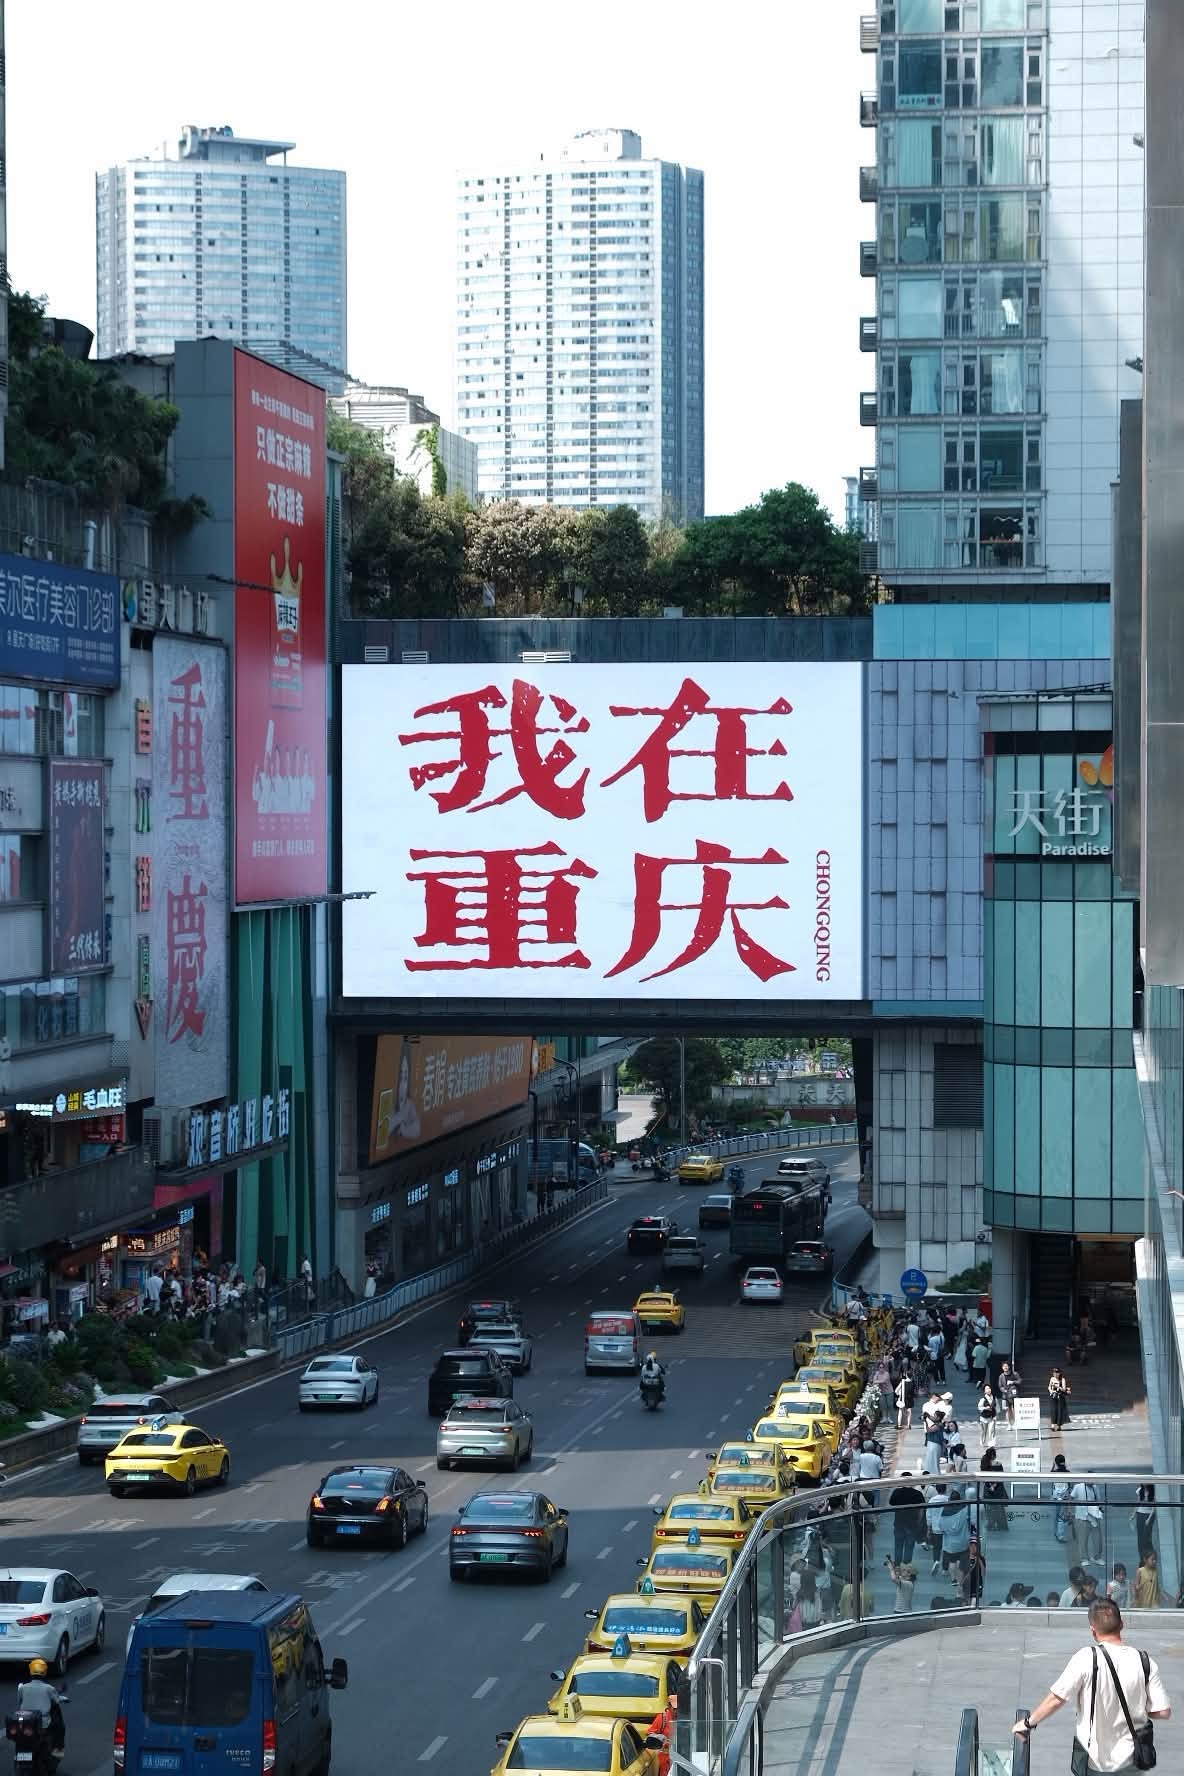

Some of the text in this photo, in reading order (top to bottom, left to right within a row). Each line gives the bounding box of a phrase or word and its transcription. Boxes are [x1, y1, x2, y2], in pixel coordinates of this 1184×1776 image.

[398, 678, 794, 823] 我在
[1007, 787, 1105, 837] 天街
[1042, 842, 1110, 856] Paradise
[404, 839, 798, 983] 重庆
[815, 849, 831, 983] CHONGQING
[83, 1088, 122, 1110] 毛血旺
